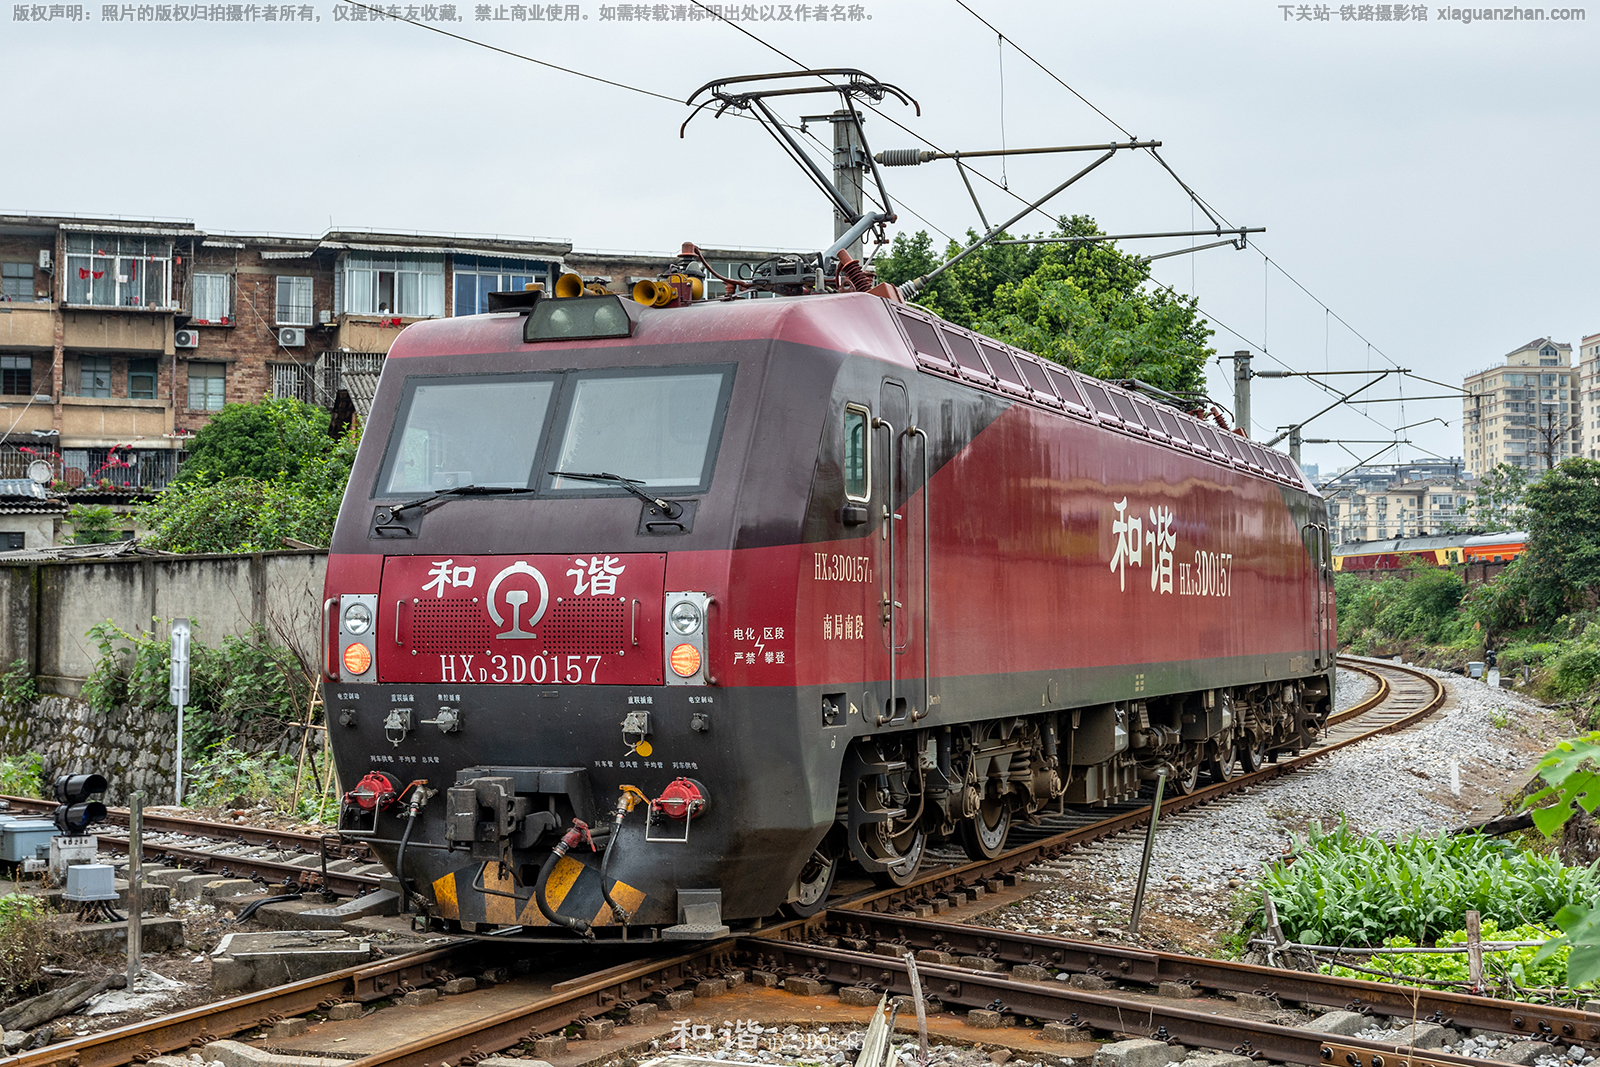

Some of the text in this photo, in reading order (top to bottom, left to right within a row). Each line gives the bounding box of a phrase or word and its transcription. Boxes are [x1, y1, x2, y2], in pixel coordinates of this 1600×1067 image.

[1110, 496, 1177, 595] 和谐
[421, 555, 626, 599] 和 谐
[733, 626, 785, 641] 电化 区段
[823, 613, 864, 640] 南局南段
[440, 654, 602, 684] HXD3D0157
[733, 651, 786, 665] 严禁 攀登
